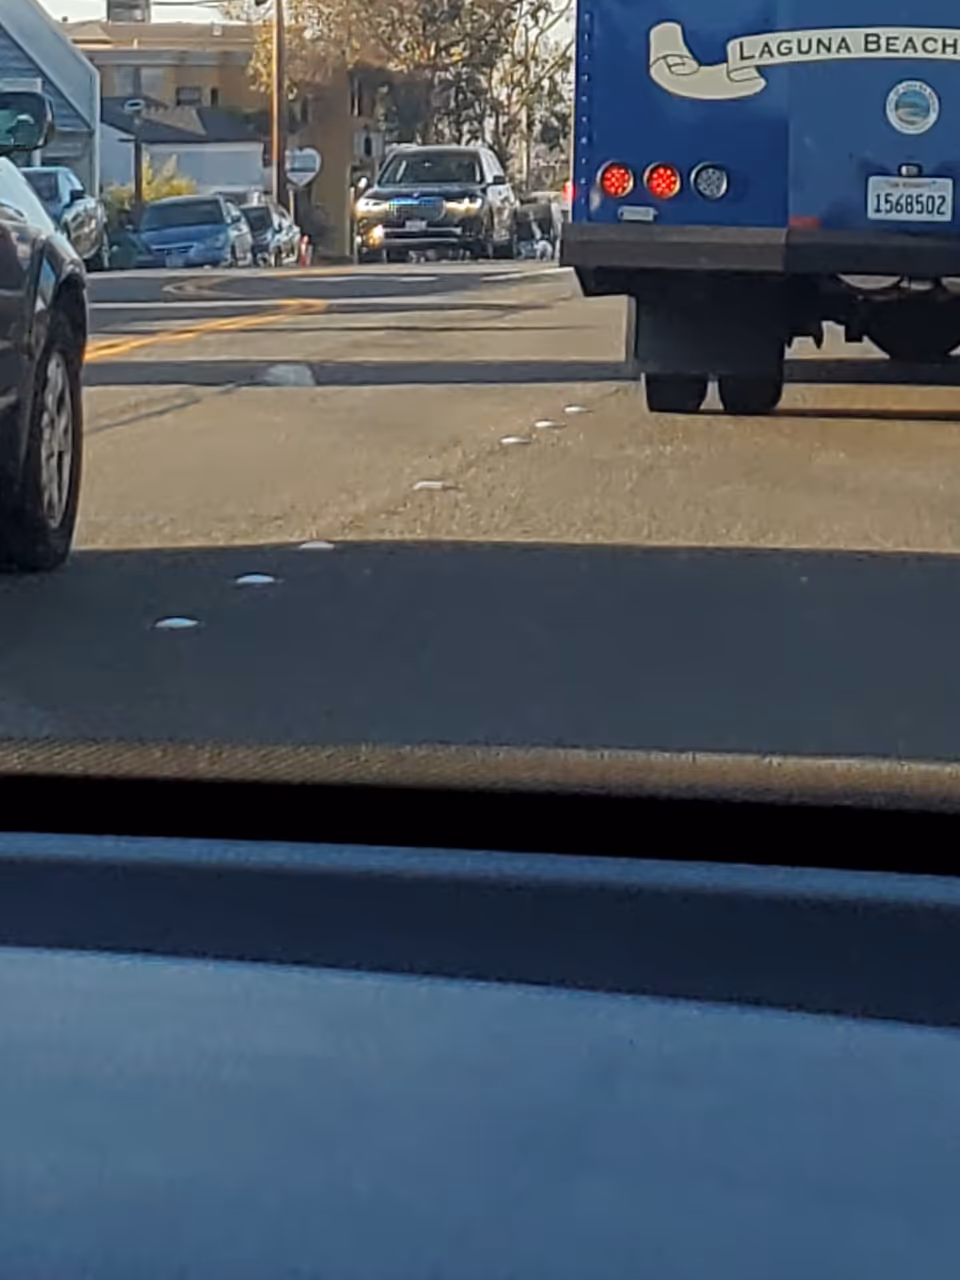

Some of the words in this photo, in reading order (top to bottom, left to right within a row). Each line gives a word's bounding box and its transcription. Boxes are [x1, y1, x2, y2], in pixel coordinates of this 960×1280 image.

[738, 34, 852, 61] LAGUNA
[863, 33, 959, 56] BEACH
[873, 192, 947, 216] 1568502
